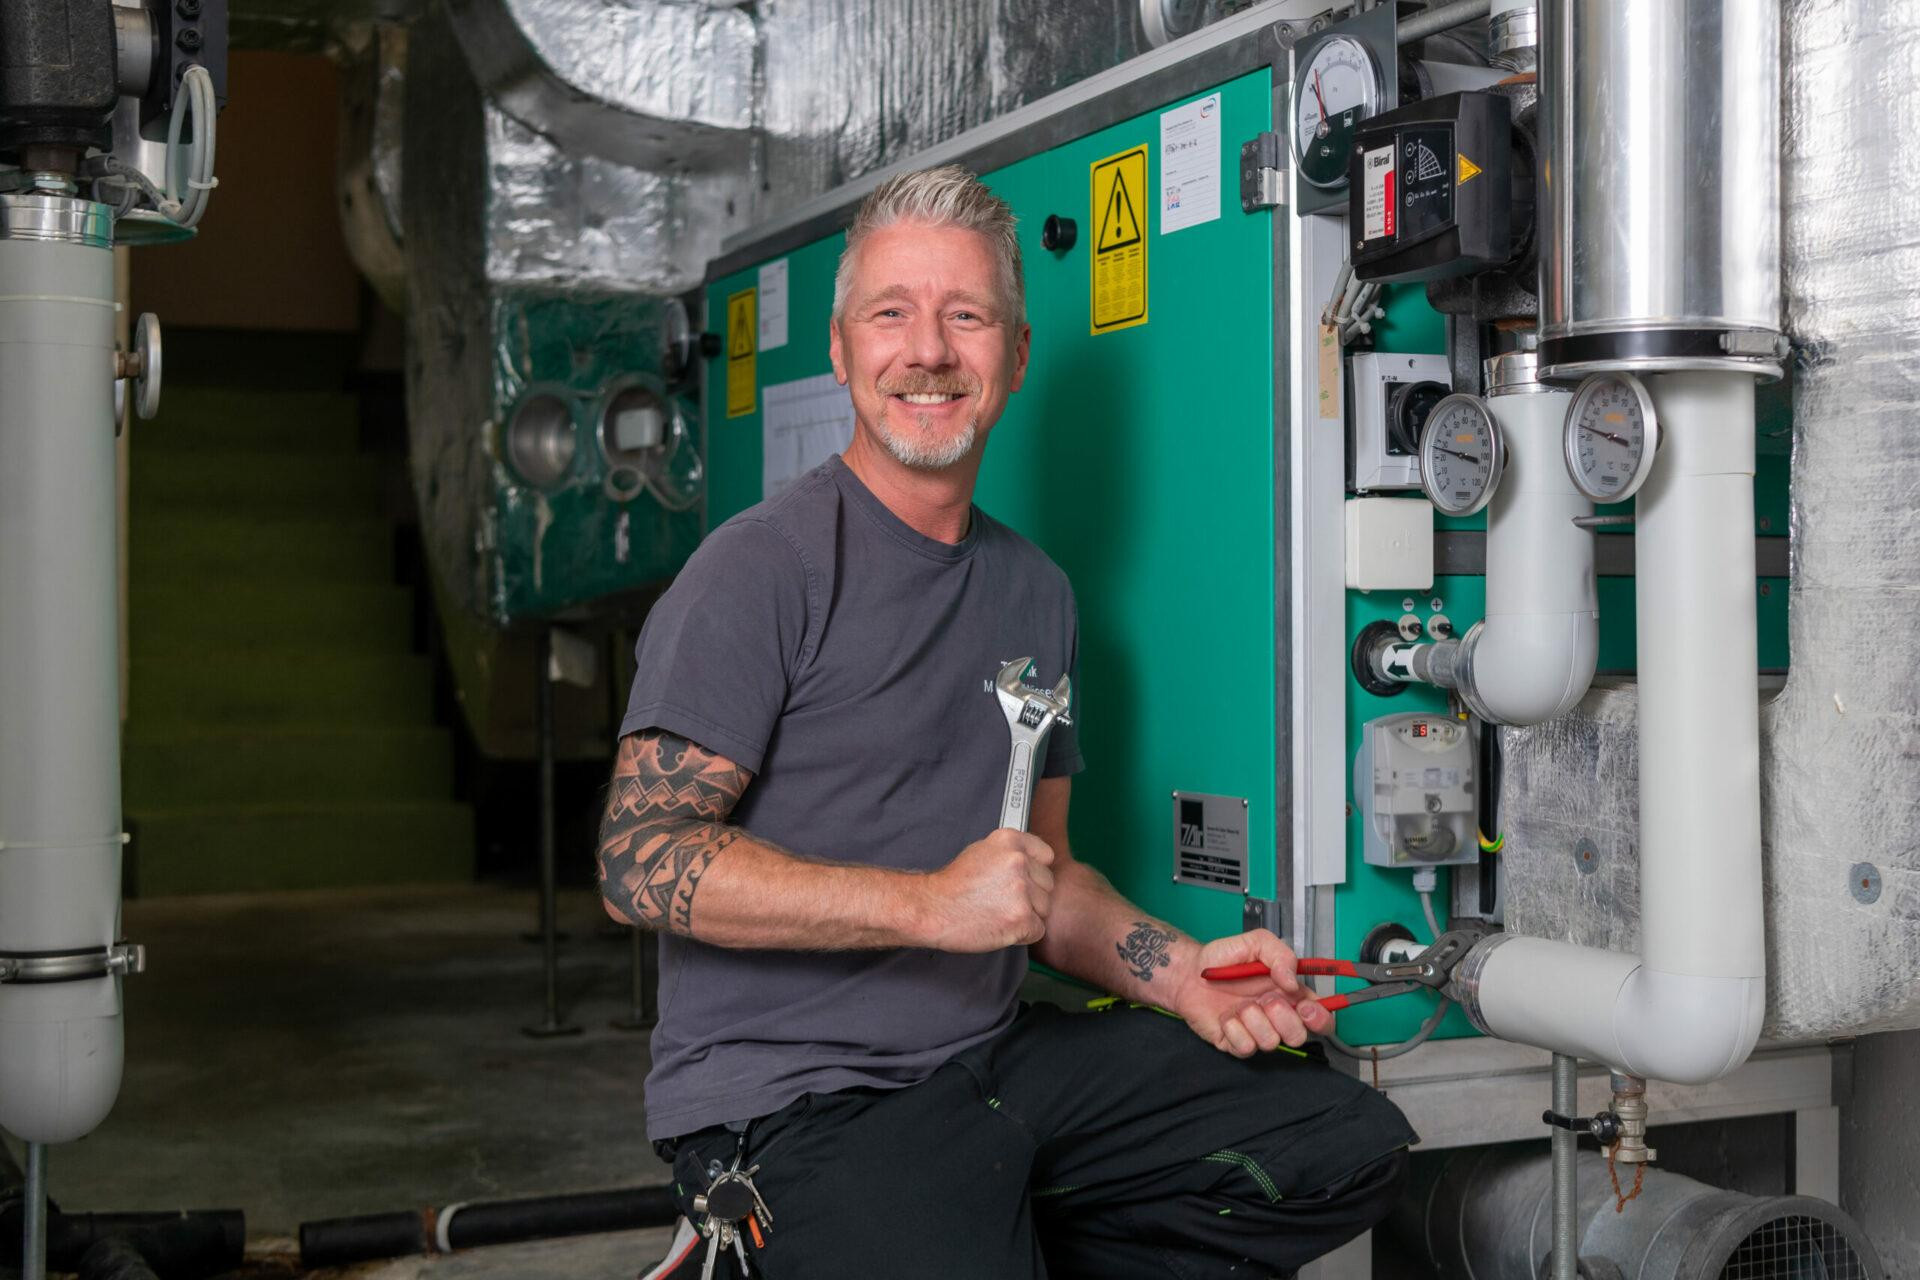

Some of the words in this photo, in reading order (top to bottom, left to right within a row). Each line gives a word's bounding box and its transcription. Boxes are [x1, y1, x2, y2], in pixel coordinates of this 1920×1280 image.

[1374, 153, 1391, 167] Biral
[1478, 466, 1487, 474] 110
[1010, 768, 1026, 809] FORGED
